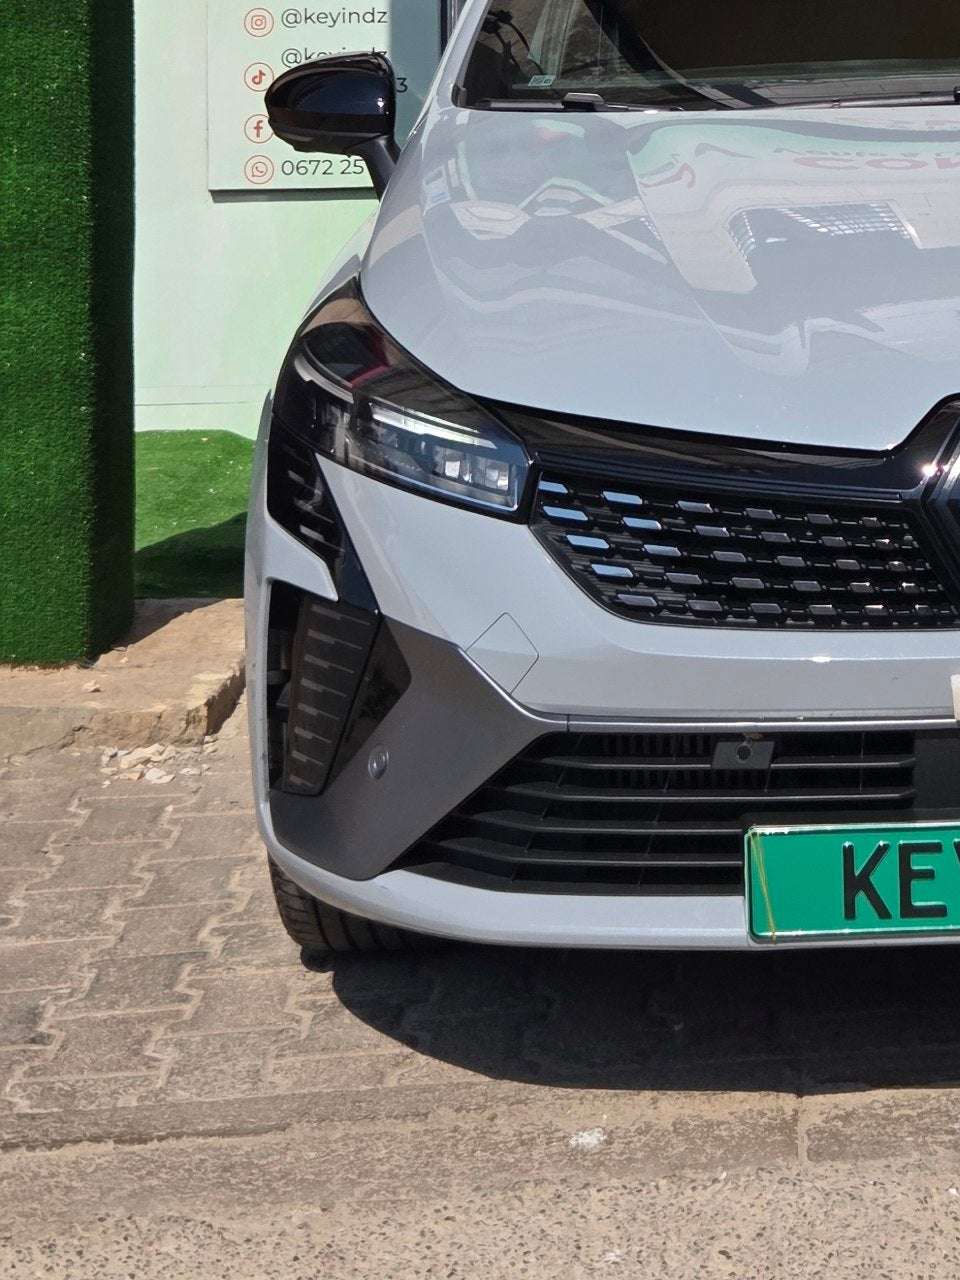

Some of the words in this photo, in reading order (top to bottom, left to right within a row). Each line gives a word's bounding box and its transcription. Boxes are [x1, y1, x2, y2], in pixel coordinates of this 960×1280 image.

[281, 7, 389, 28] @keyindz
[281, 160, 334, 176] 0672
[340, 160, 364, 175] 25
